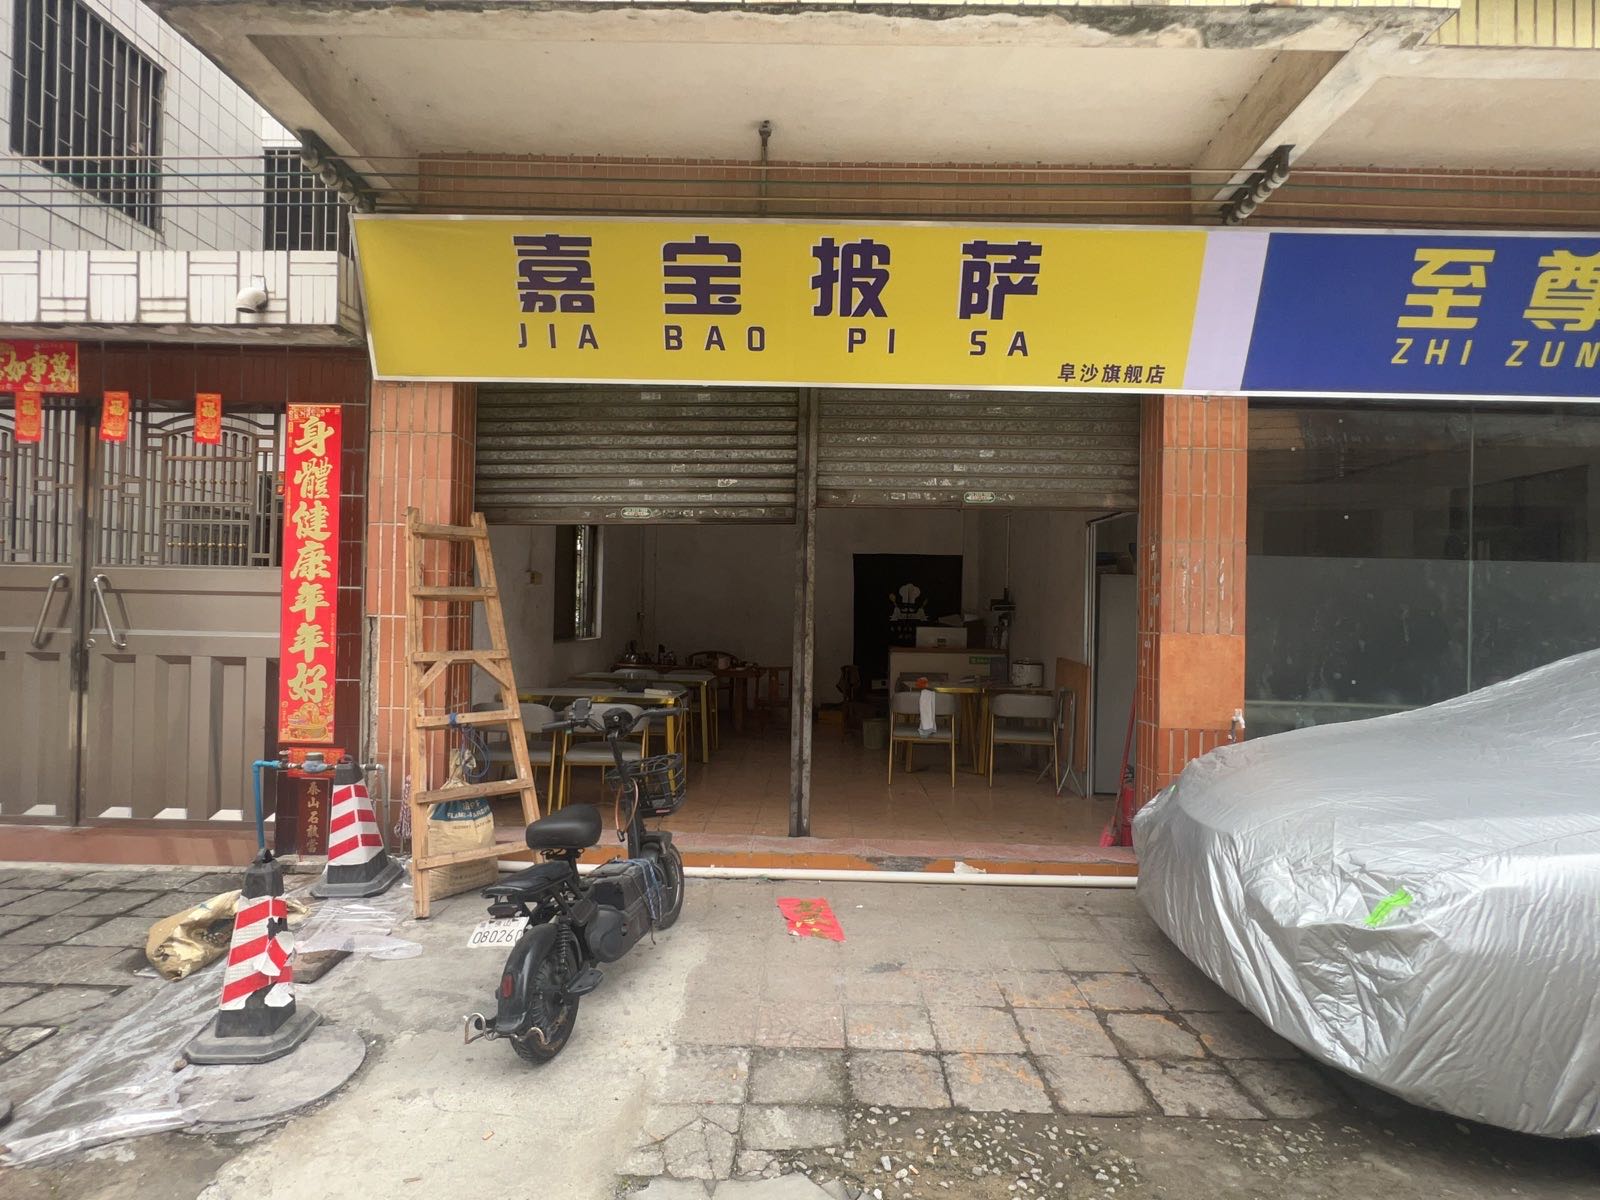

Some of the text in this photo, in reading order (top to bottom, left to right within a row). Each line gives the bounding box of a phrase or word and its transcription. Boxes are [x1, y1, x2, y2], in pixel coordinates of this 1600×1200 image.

[513, 234, 1043, 320] 嘉宝披萨
[1397, 248, 1600, 332] 至尊
[518, 323, 1029, 357] JIA BAO PI SA
[1391, 338, 1600, 368] ZHI ZUN
[1057, 363, 1165, 385] 阜沙旗舰店
[287, 415, 335, 704] 身體健康年年好
